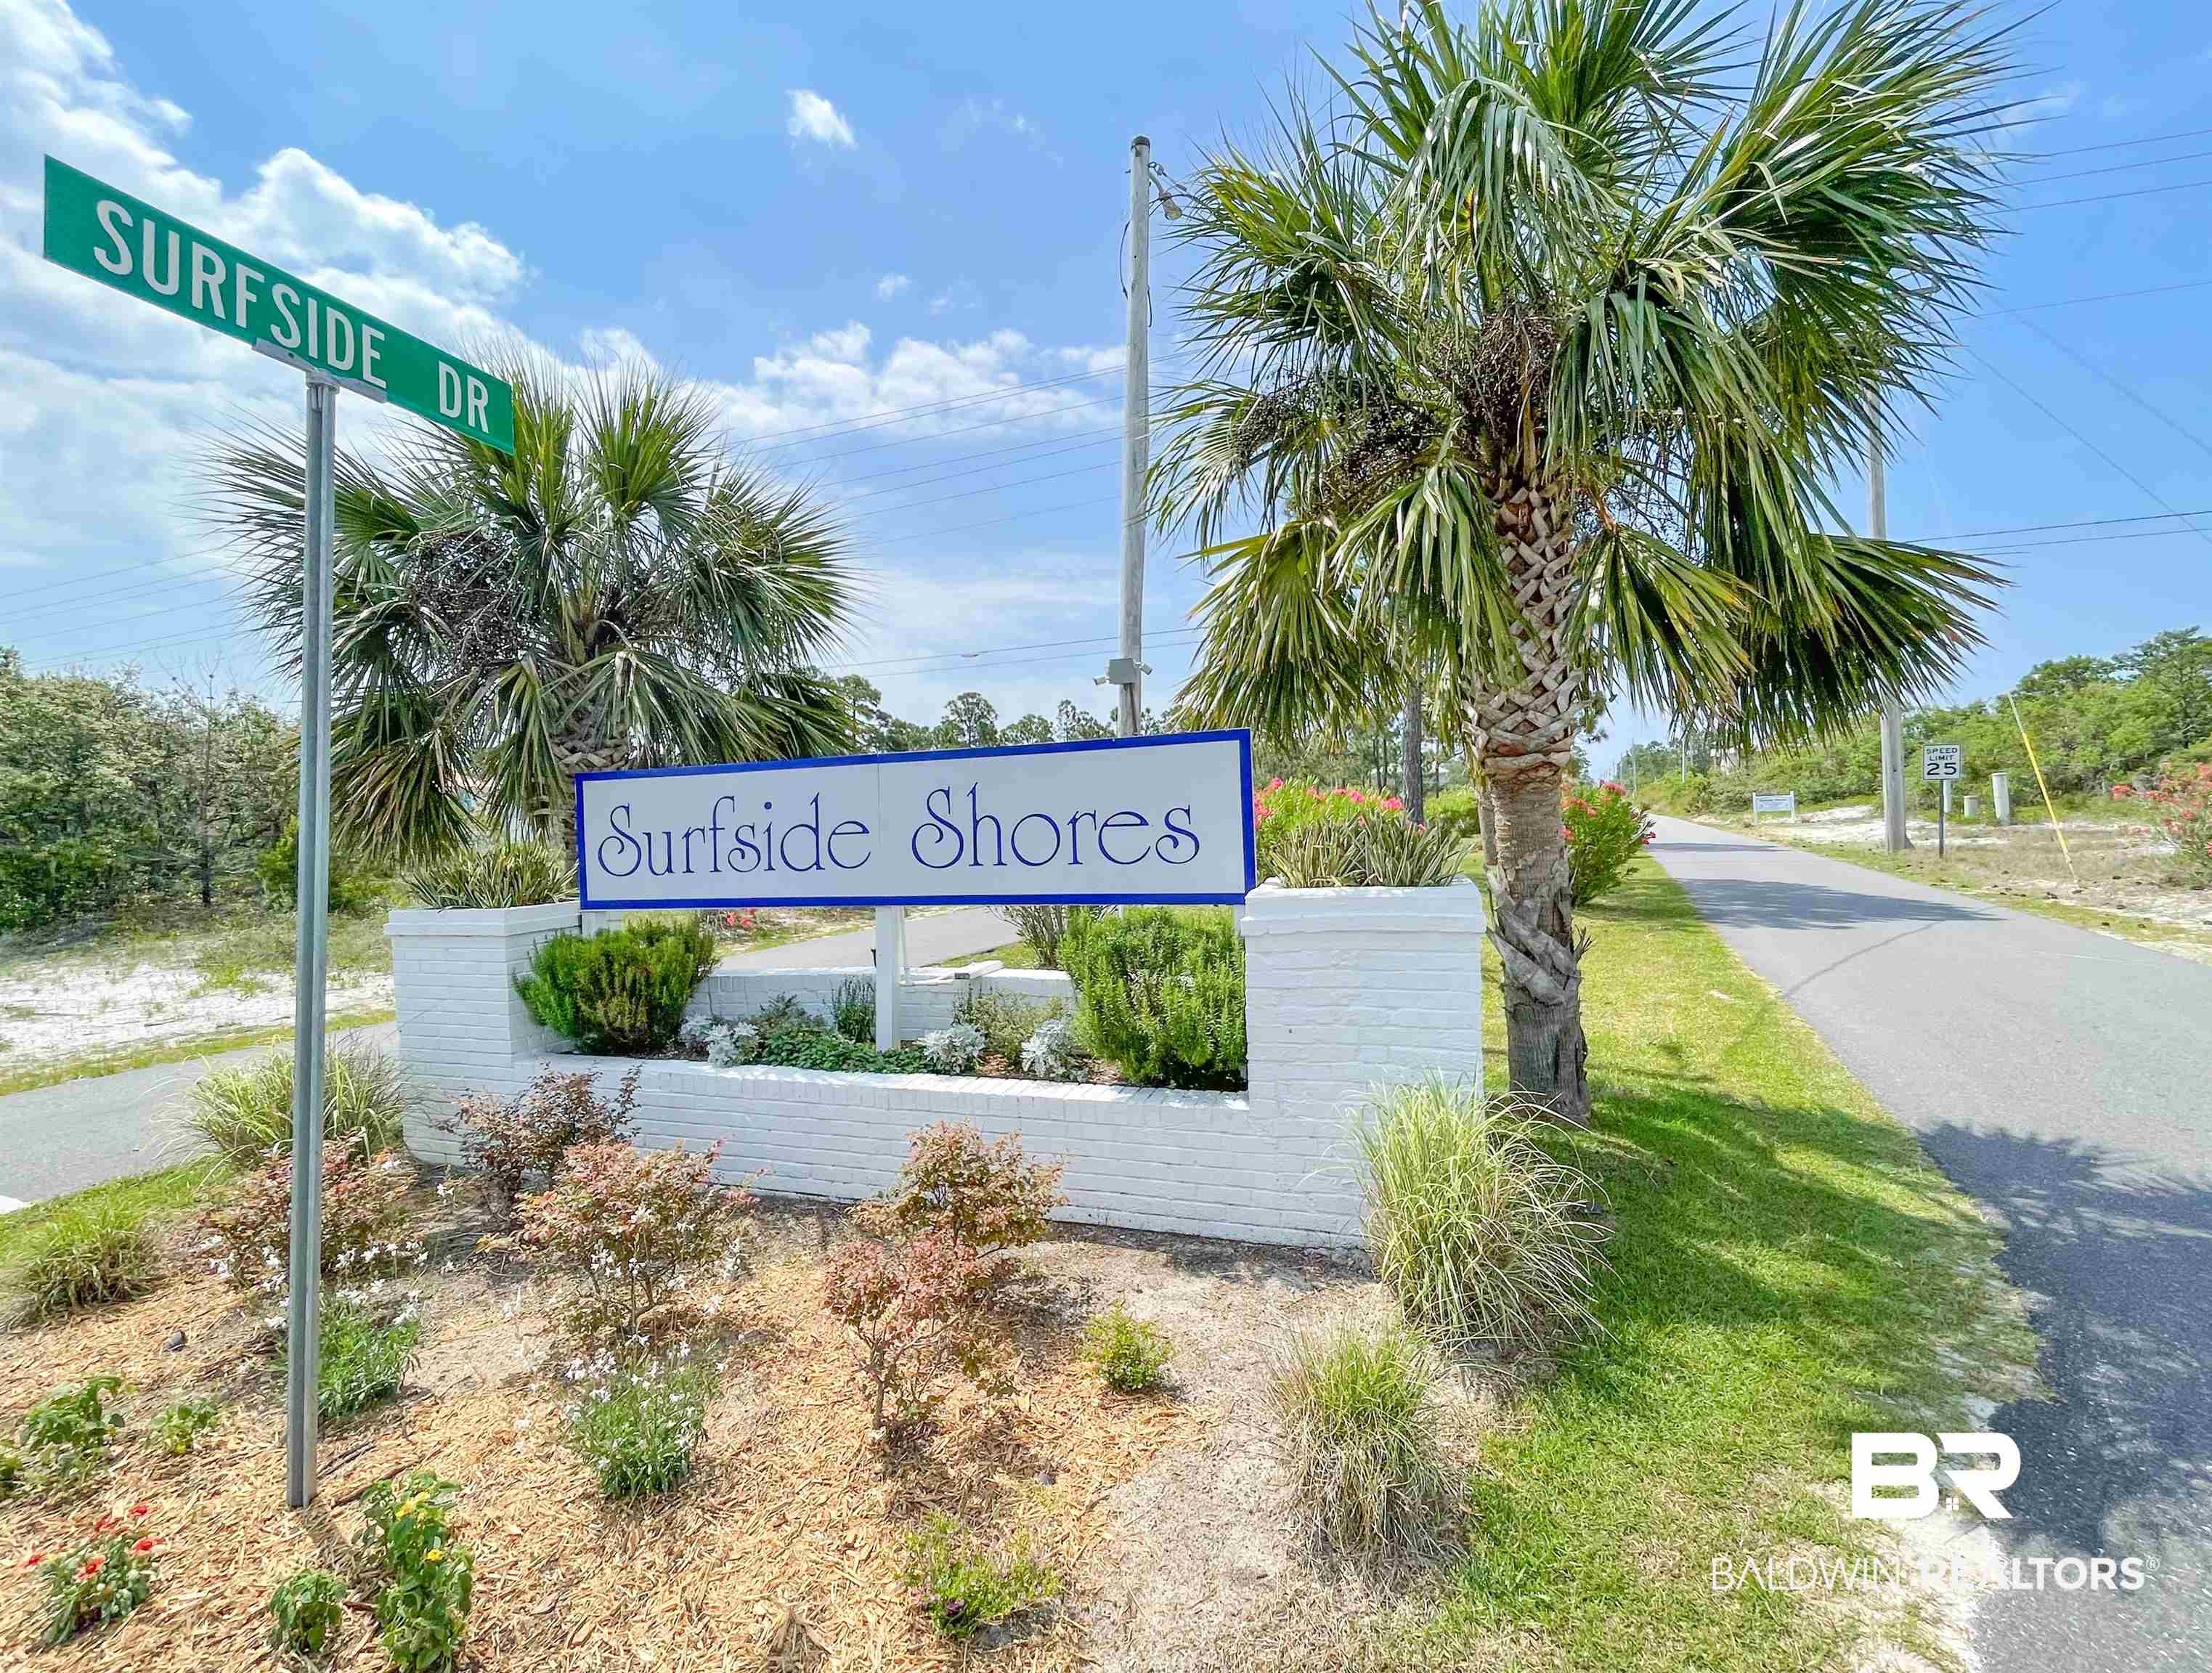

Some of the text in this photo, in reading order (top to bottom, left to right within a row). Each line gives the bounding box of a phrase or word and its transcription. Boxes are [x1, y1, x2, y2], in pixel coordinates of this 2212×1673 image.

[94, 200, 489, 433] SURFSIDE DR
[1927, 762, 1956, 775] 25
[598, 782, 1200, 877] Surfside Shores
